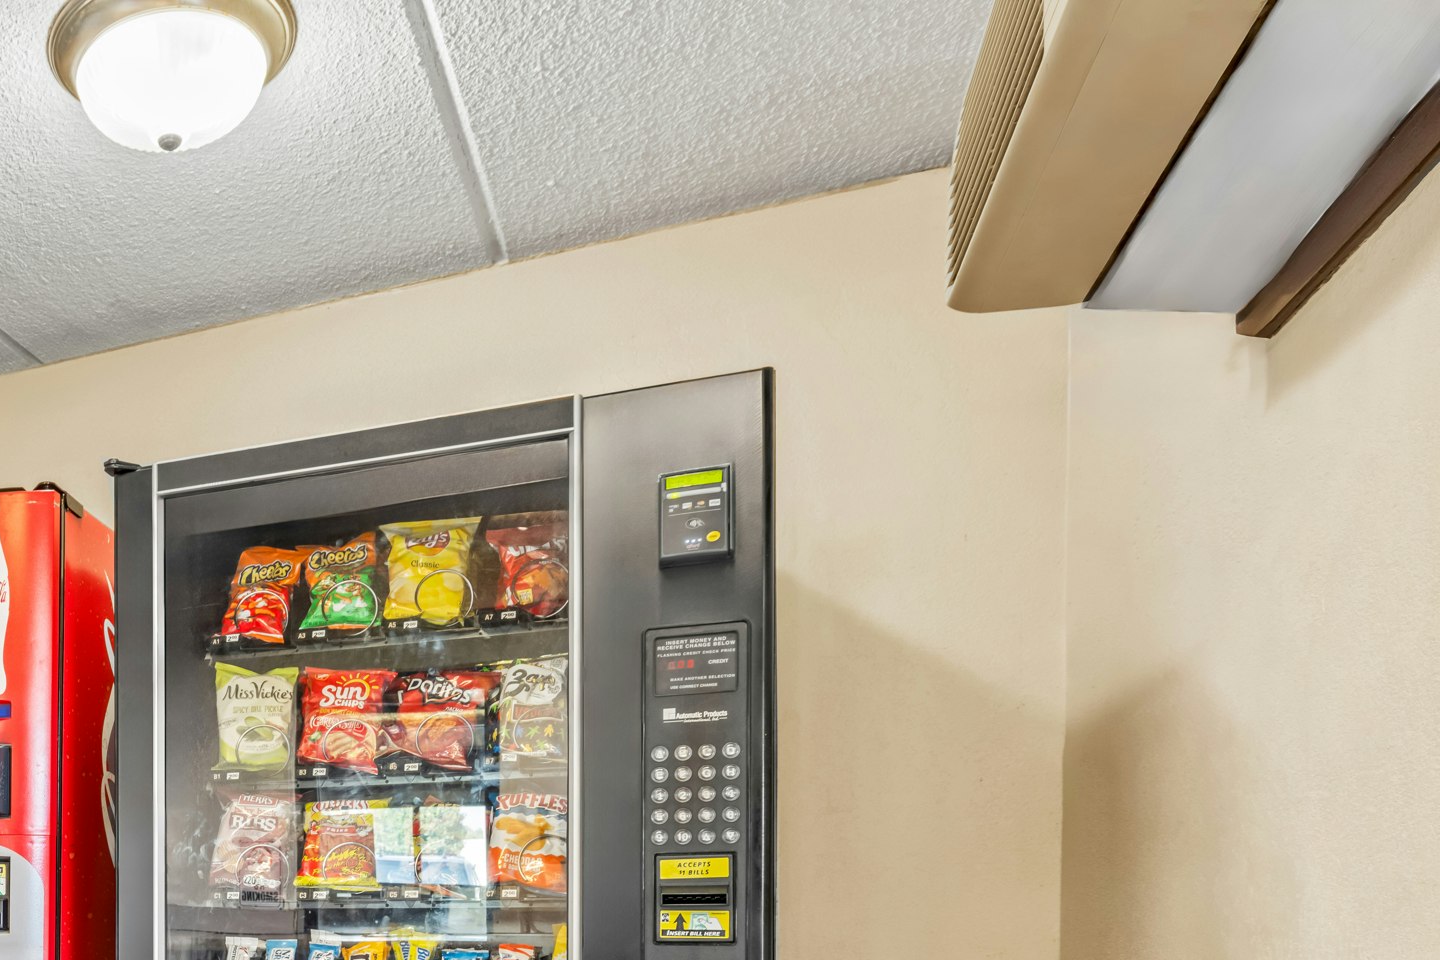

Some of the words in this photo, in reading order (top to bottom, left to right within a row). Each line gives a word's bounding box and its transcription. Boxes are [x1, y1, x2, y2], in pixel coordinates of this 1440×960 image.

[308, 543, 368, 571] Cheetos
[410, 560, 440, 568] Classic
[238, 560, 292, 586] Cheetos
[222, 684, 254, 700] Miss
[252, 680, 294, 704] Vickie's
[320, 683, 369, 708] Sun
[408, 676, 472, 704] Doritos
[335, 699, 364, 710] CHIPS
[676, 711, 702, 720] Automatic
[704, 710, 728, 718] Products
[496, 792, 568, 814] RUFFLES
